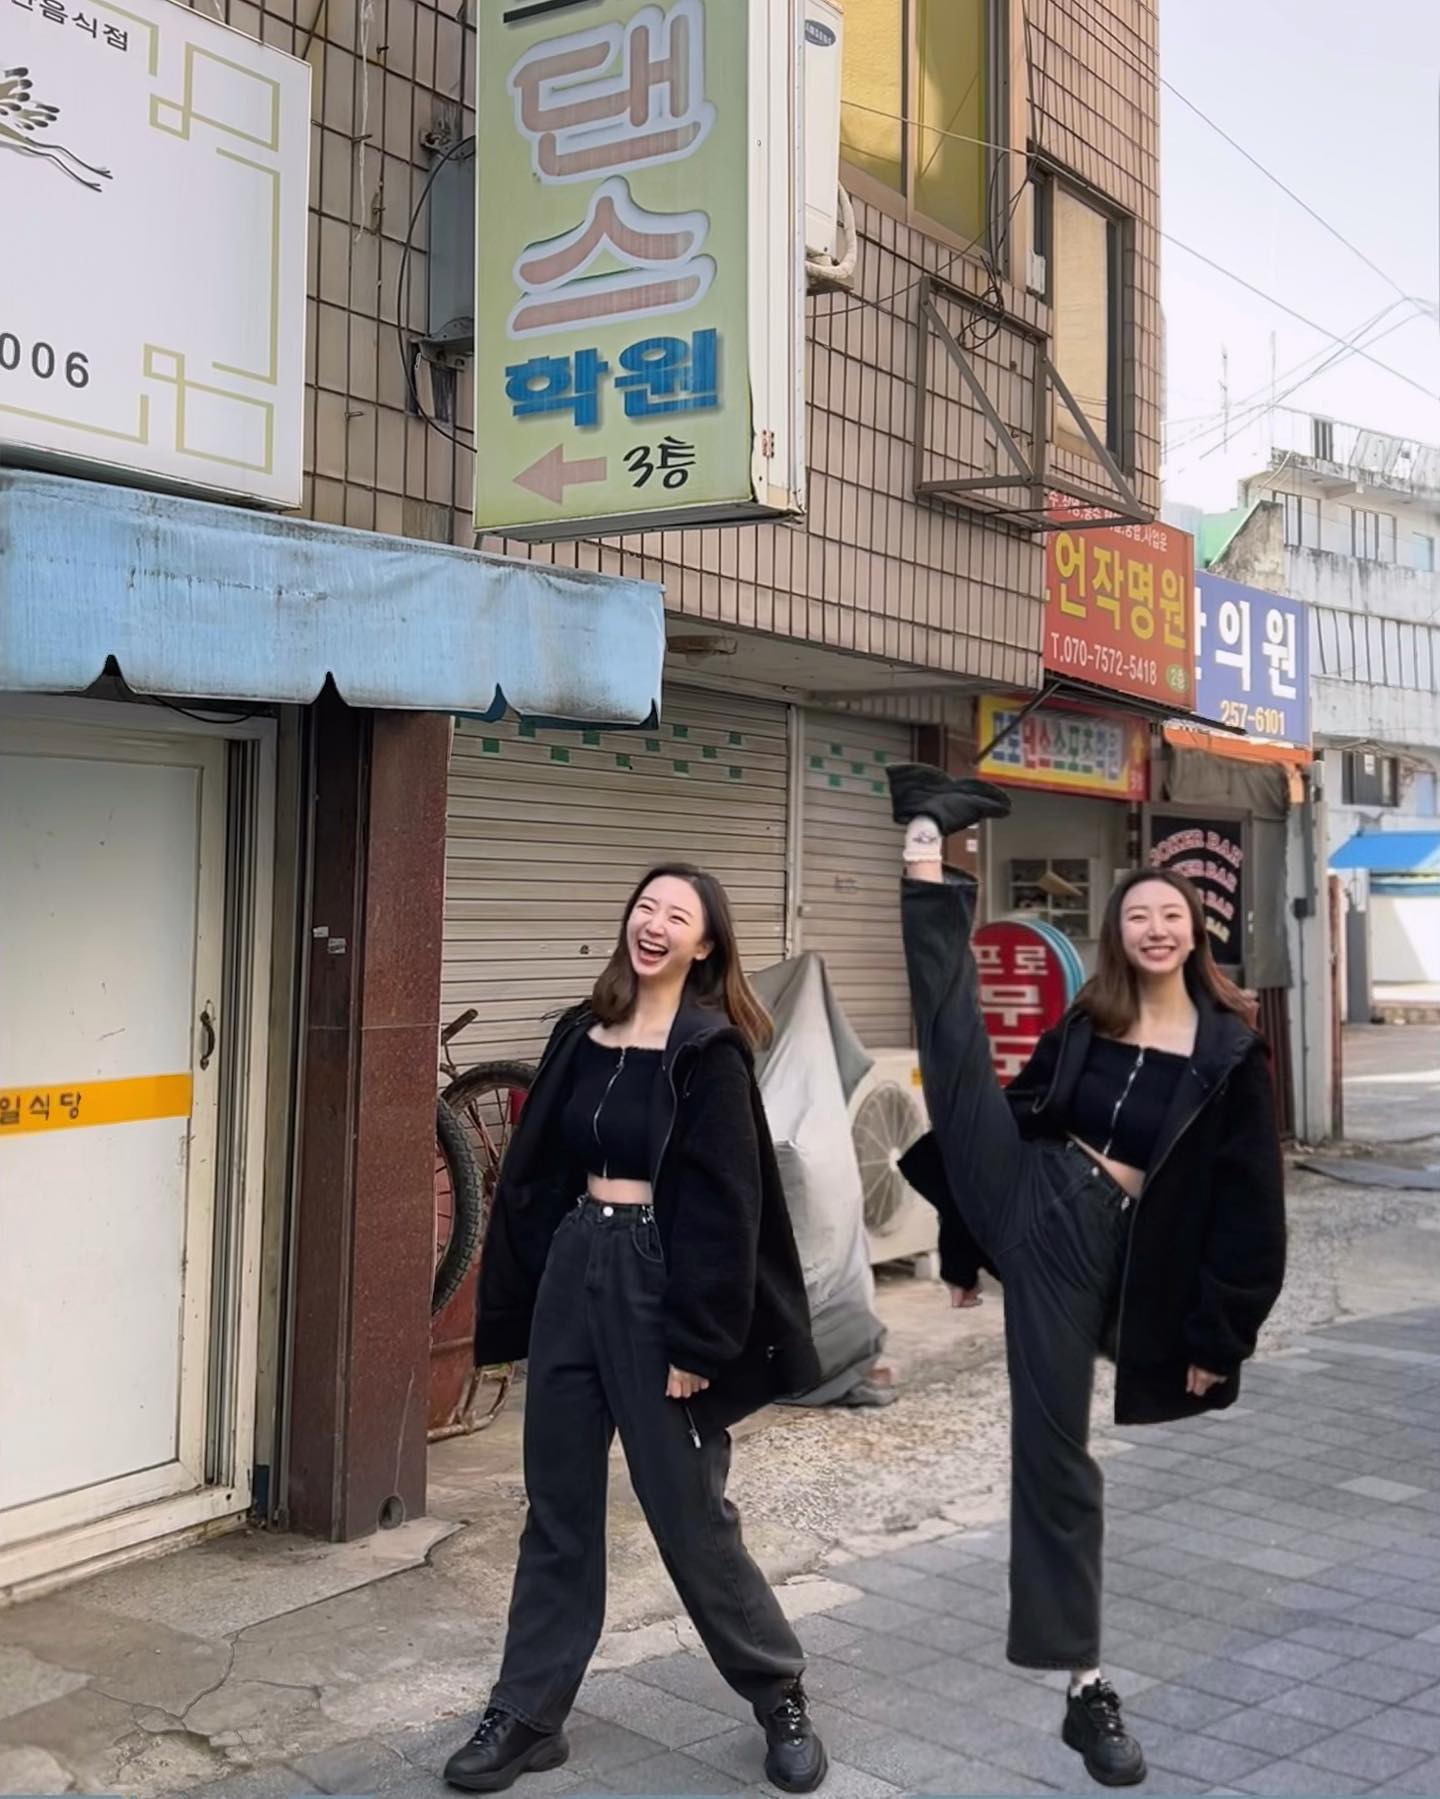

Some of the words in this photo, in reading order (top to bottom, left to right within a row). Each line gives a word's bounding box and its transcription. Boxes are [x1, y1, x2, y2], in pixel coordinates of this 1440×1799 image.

[506, 0, 717, 341] 댄스
[505, 328, 719, 427] 학원
[1044, 531, 1187, 650] 언작명원
[1220, 700, 1286, 736] 257-6101
